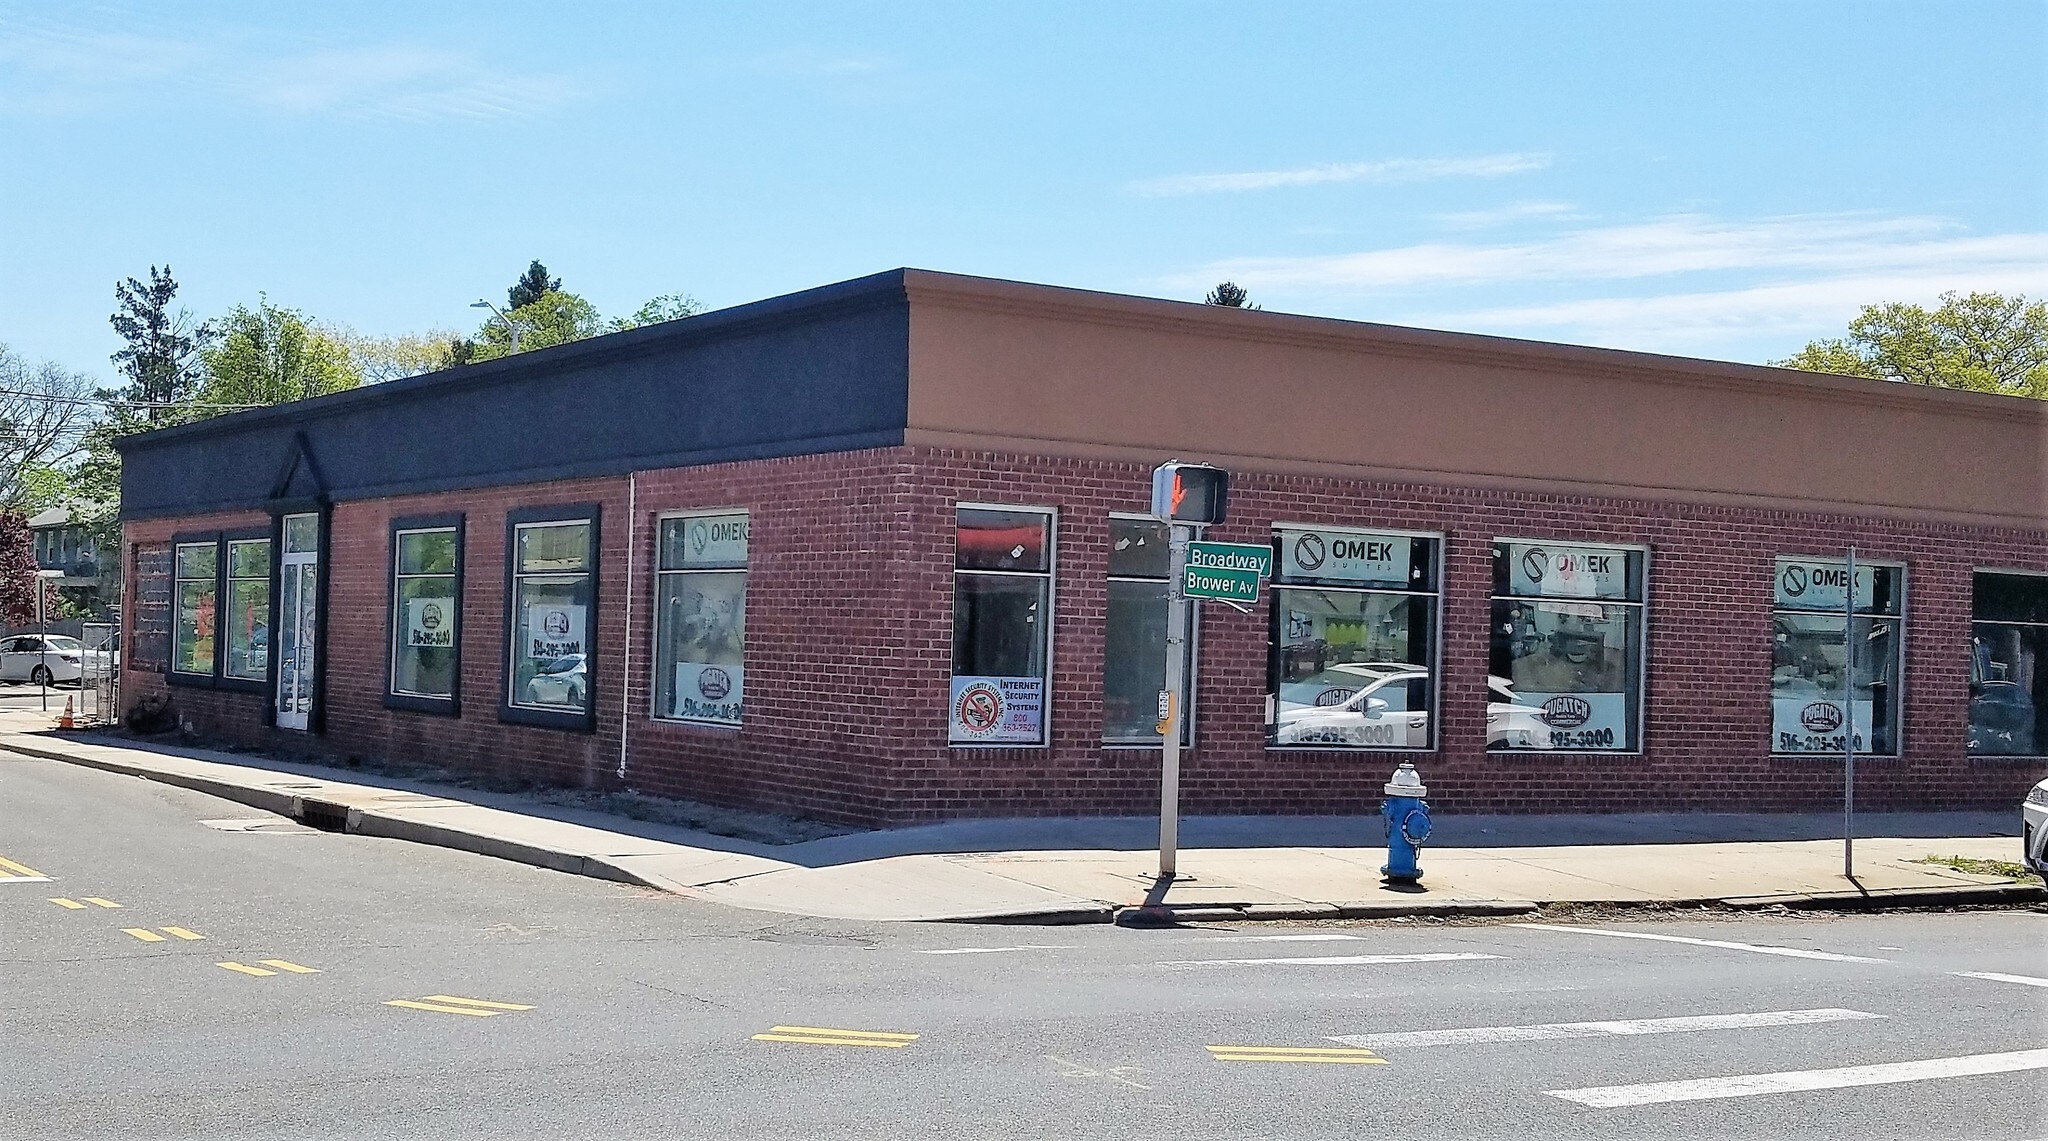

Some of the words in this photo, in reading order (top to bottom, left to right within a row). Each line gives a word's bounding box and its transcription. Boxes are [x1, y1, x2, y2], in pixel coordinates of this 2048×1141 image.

[712, 522, 748, 542] OMEK
[1332, 539, 1393, 562] OMEK
[1191, 549, 1267, 573] Broadway
[1332, 562, 1392, 571] SUITES
[1556, 553, 1611, 573] OMEK
[1187, 572, 1236, 592] Brower
[1238, 580, 1254, 594] Av
[1812, 569, 1860, 588] OMEK
[1000, 679, 1041, 690] INTERNET
[1005, 691, 1039, 700] SECURITY
[1006, 703, 1039, 711] SYSTEMS
[1544, 697, 1588, 719] PUGATCH
[1779, 731, 1862, 751] 516-295-300
